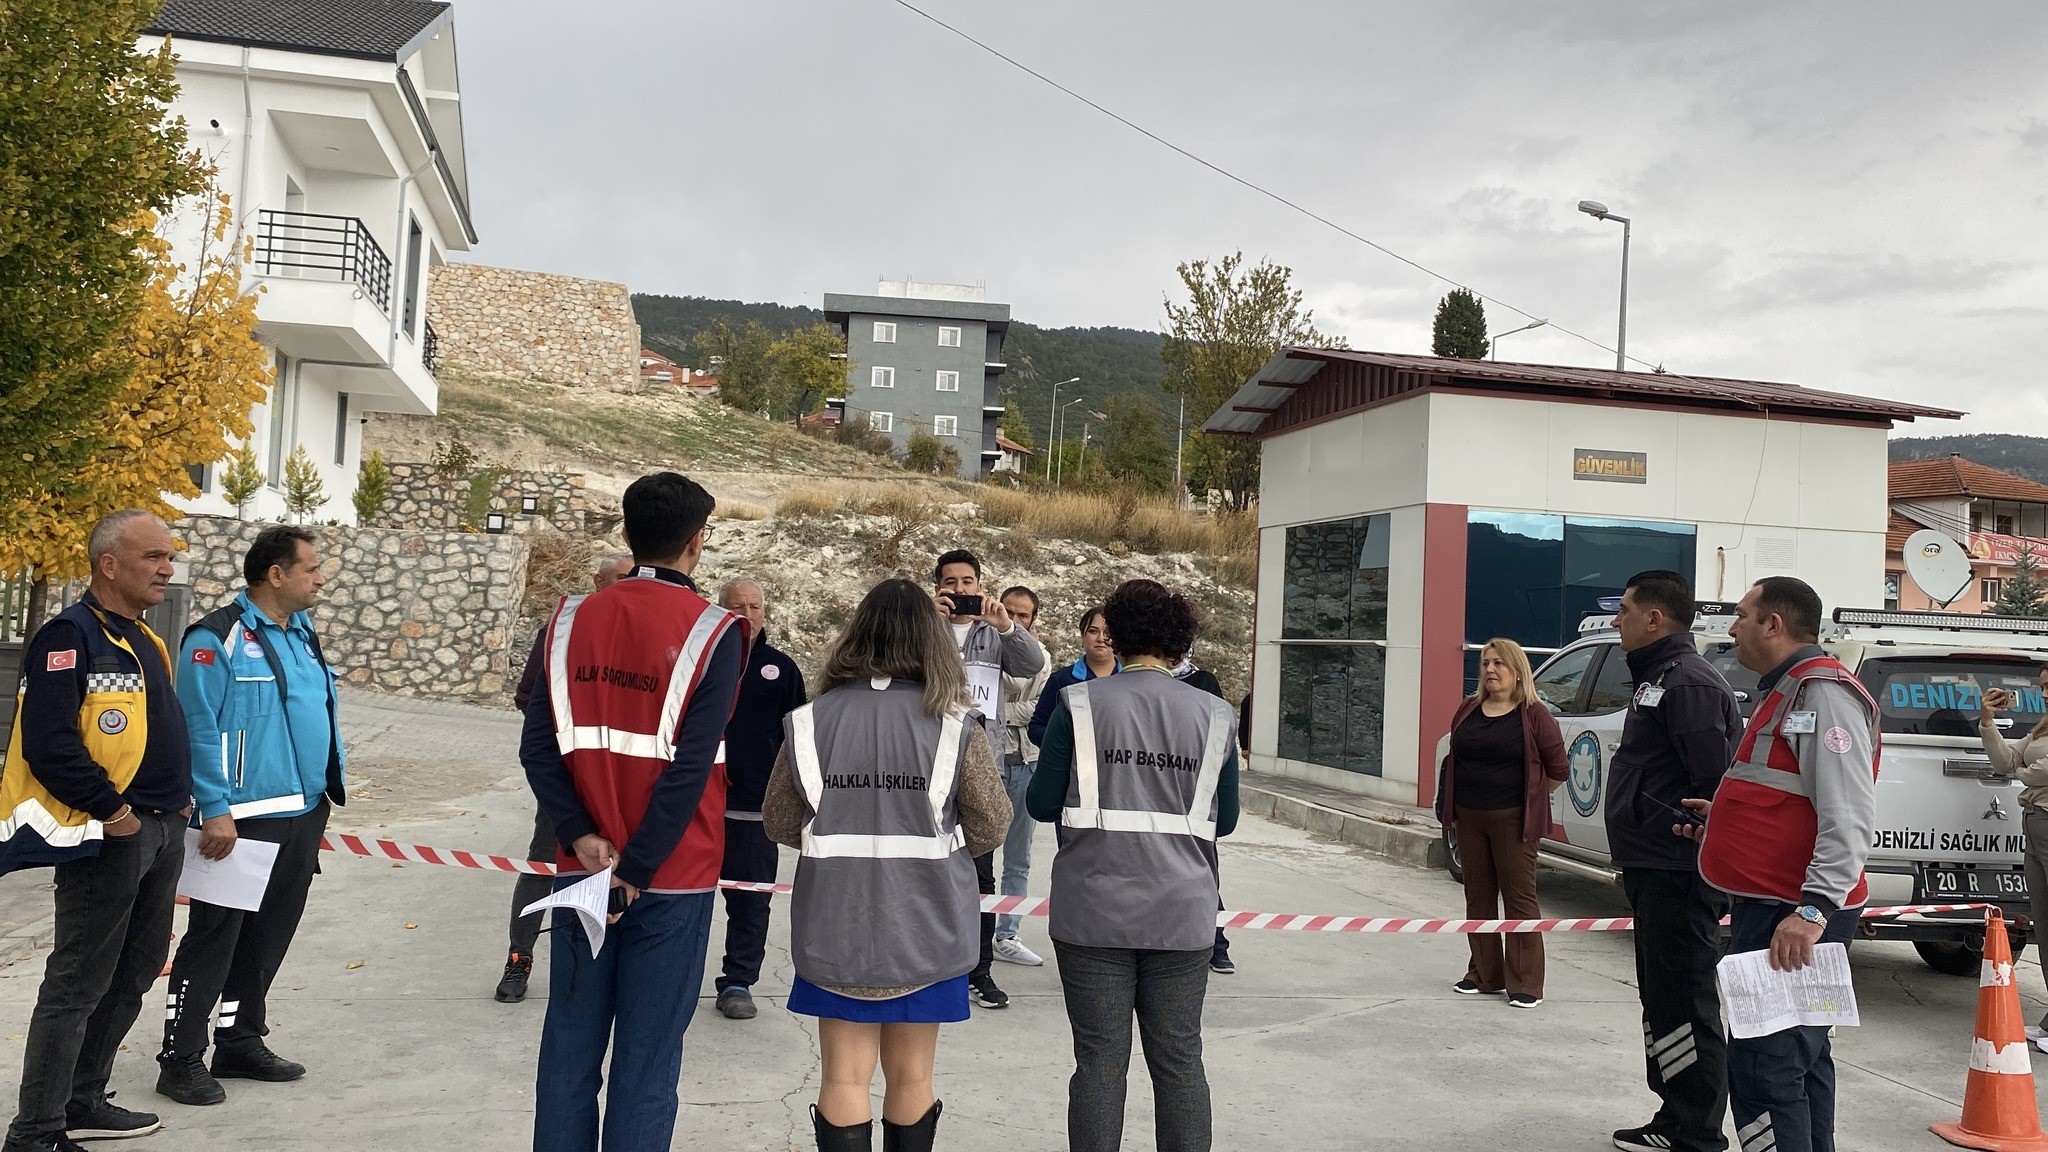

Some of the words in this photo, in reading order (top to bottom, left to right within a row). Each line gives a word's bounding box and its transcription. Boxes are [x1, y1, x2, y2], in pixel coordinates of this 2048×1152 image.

[1575, 455, 1646, 477] GÜVENLİK
[601, 666, 660, 694] SORUMLUSU
[1890, 679, 1993, 711] DENİZL
[1104, 749, 1133, 765] HAP
[1136, 750, 1198, 773] BAŞKANI
[823, 774, 871, 789] HALKLA
[874, 770, 927, 793] İLİŞKİLER
[1873, 827, 1935, 850] DENİZLİ
[1939, 829, 2001, 852] SAĞLIK
[1937, 872, 1957, 891] 20
[1968, 873, 1980, 892] R
